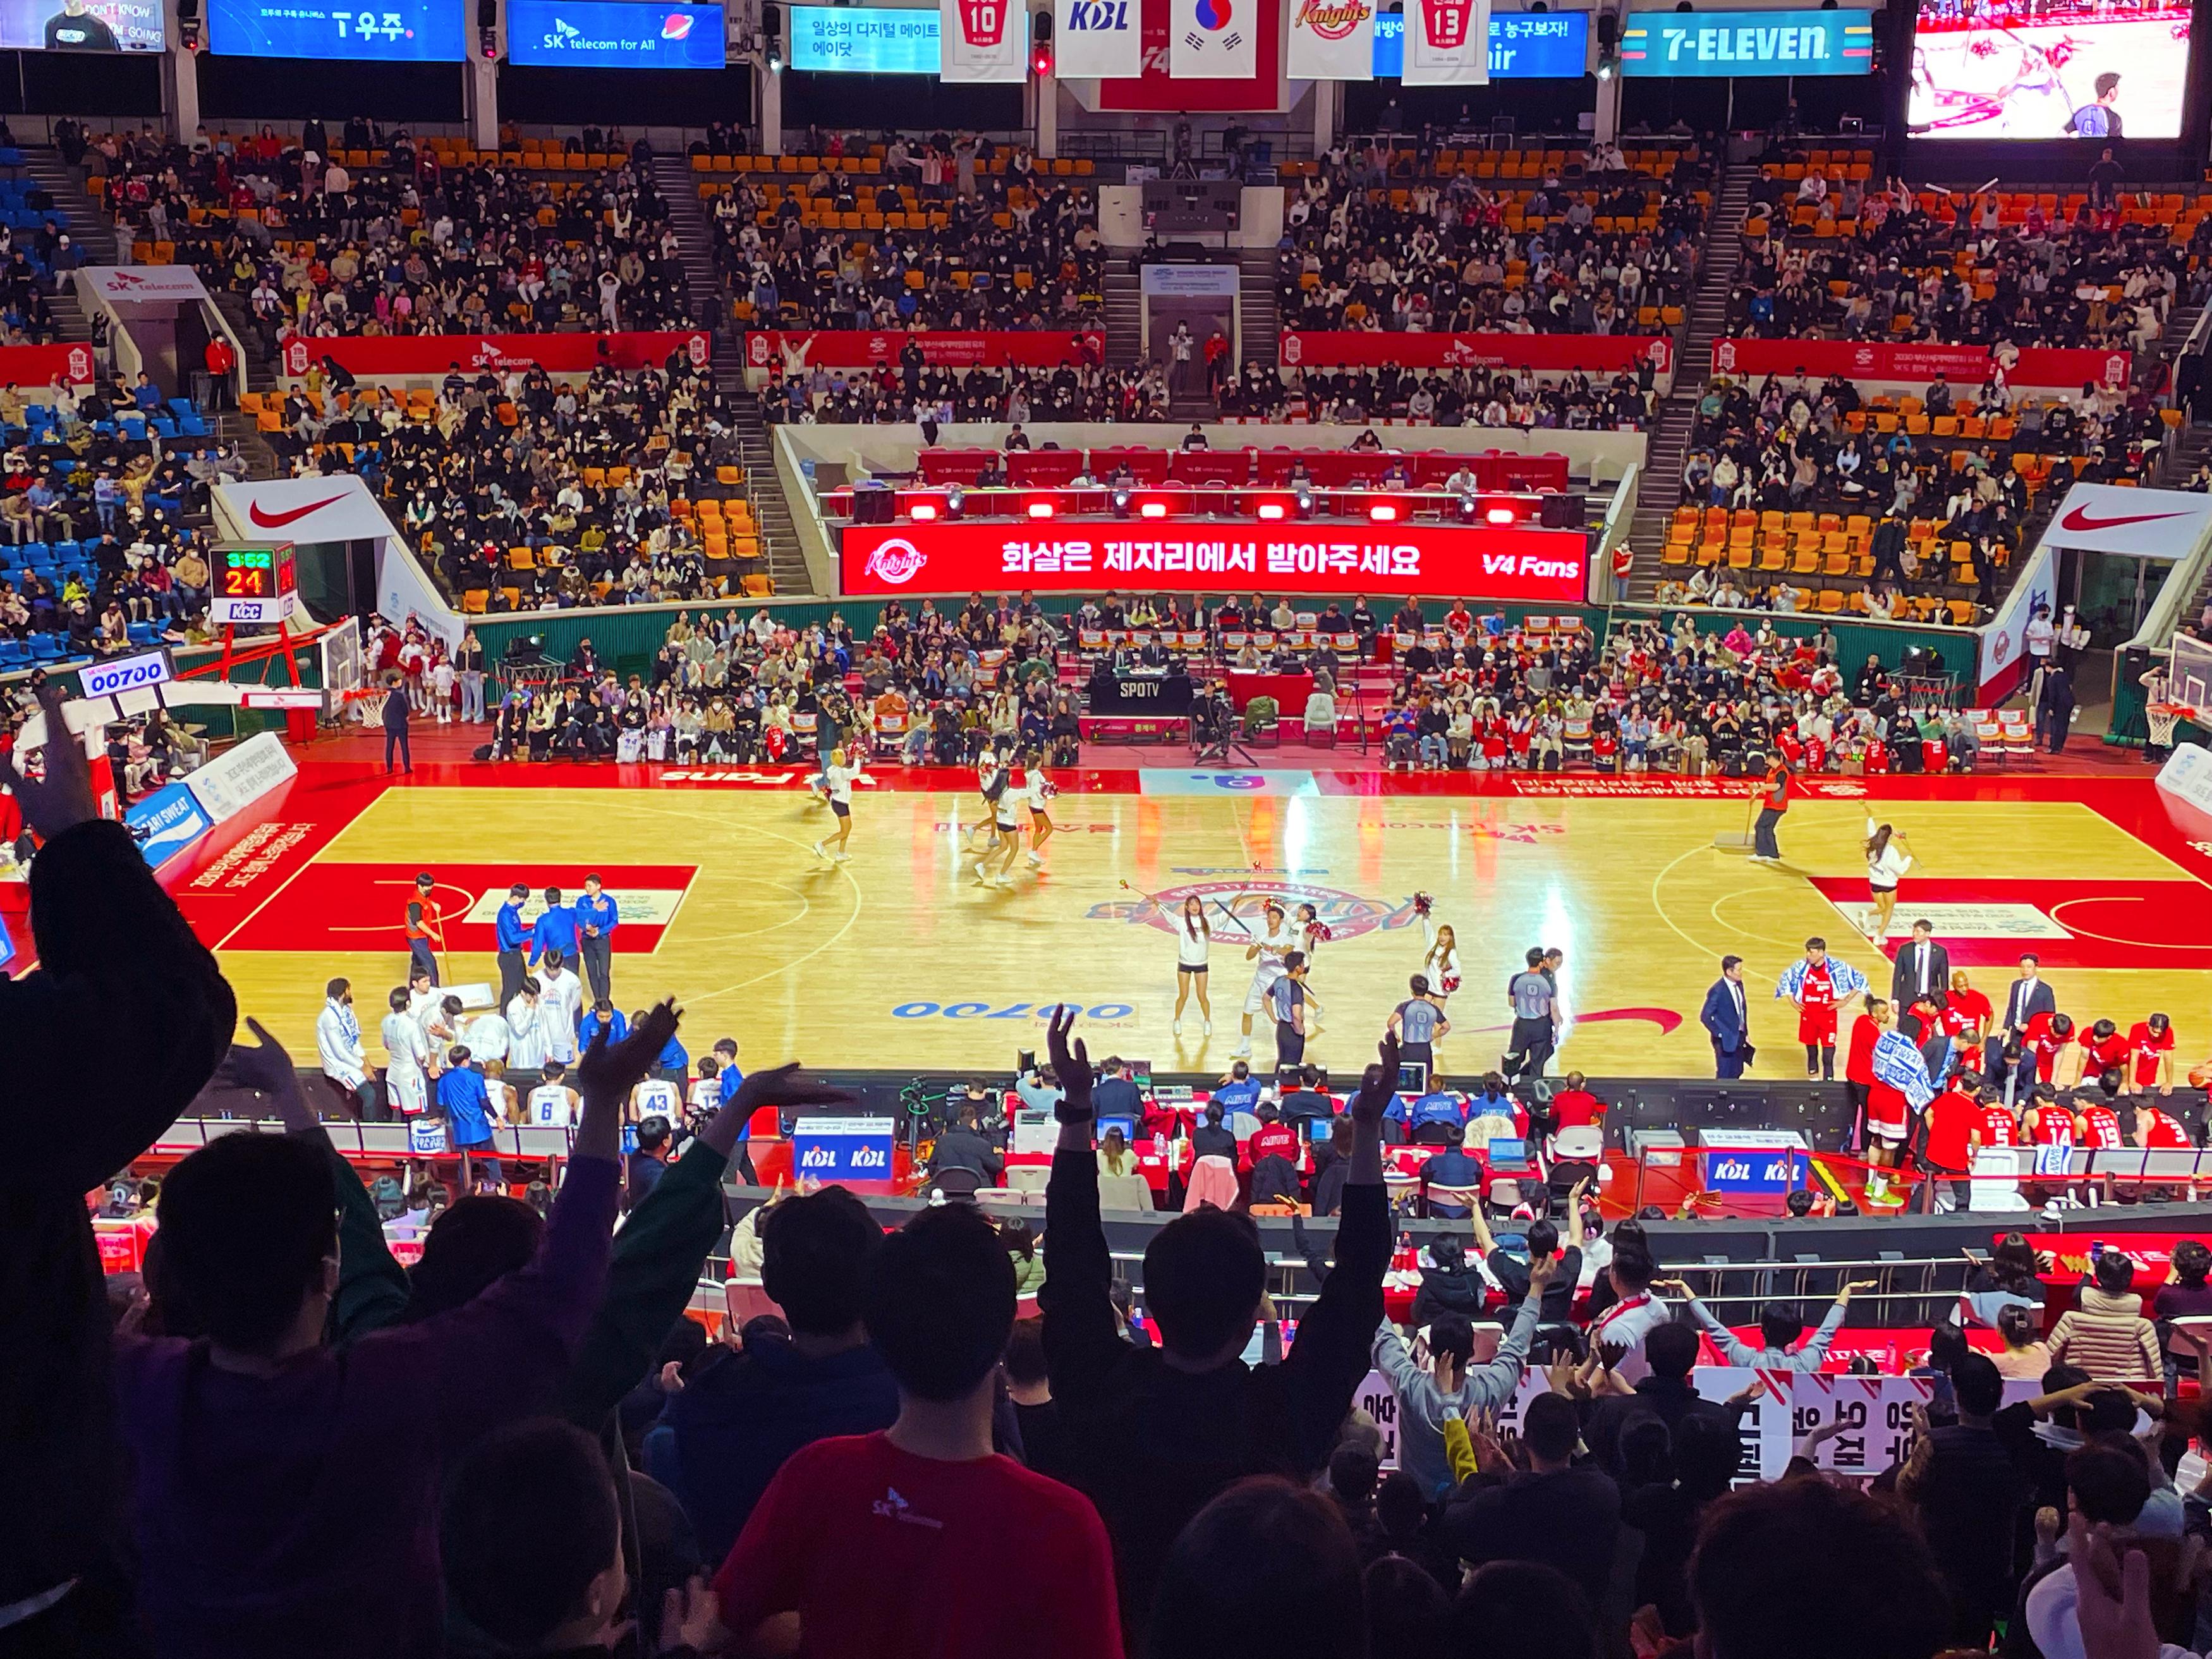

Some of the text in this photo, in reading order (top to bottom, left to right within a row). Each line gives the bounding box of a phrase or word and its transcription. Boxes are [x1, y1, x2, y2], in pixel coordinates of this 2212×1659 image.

[118, 3, 150, 18] KNOW
[971, 6, 995, 32] 10
[1068, 1, 1127, 30] KBL
[1295, 0, 1371, 28] Knights
[812, 21, 939, 38] 일상의 디지털 메이트
[1434, 9, 1459, 35] 13
[1505, 21, 1569, 38] 농구보자!
[128, 27, 162, 43] GOING
[544, 33, 655, 51] SK telecom for All
[812, 41, 853, 58] 에이닷
[106, 281, 194, 292] SK telecom
[472, 355, 533, 367] SK telecom
[1443, 351, 1504, 364] SK telecom
[865, 549, 928, 576] Knights
[1002, 541, 1421, 576] 화살은 제자리에서 받아주세요
[1482, 554, 1579, 578] V4 Fans
[226, 571, 262, 595] 24
[231, 604, 260, 619] KCC
[92, 664, 161, 691] 00700
[1120, 682, 1160, 698] SPOTV
[160, 796, 190, 824] SWEAT
[892, 1002, 1134, 1019] 00700
[646, 1095, 668, 1112] 43
[1995, 1127, 2009, 1146] 5
[2050, 1127, 2072, 1146] 14
[2098, 1127, 2120, 1149] 19
[2170, 1124, 2187, 1143] 3
[802, 1150, 885, 1167] KBL KBL
[1715, 1164, 1750, 1180] KBL
